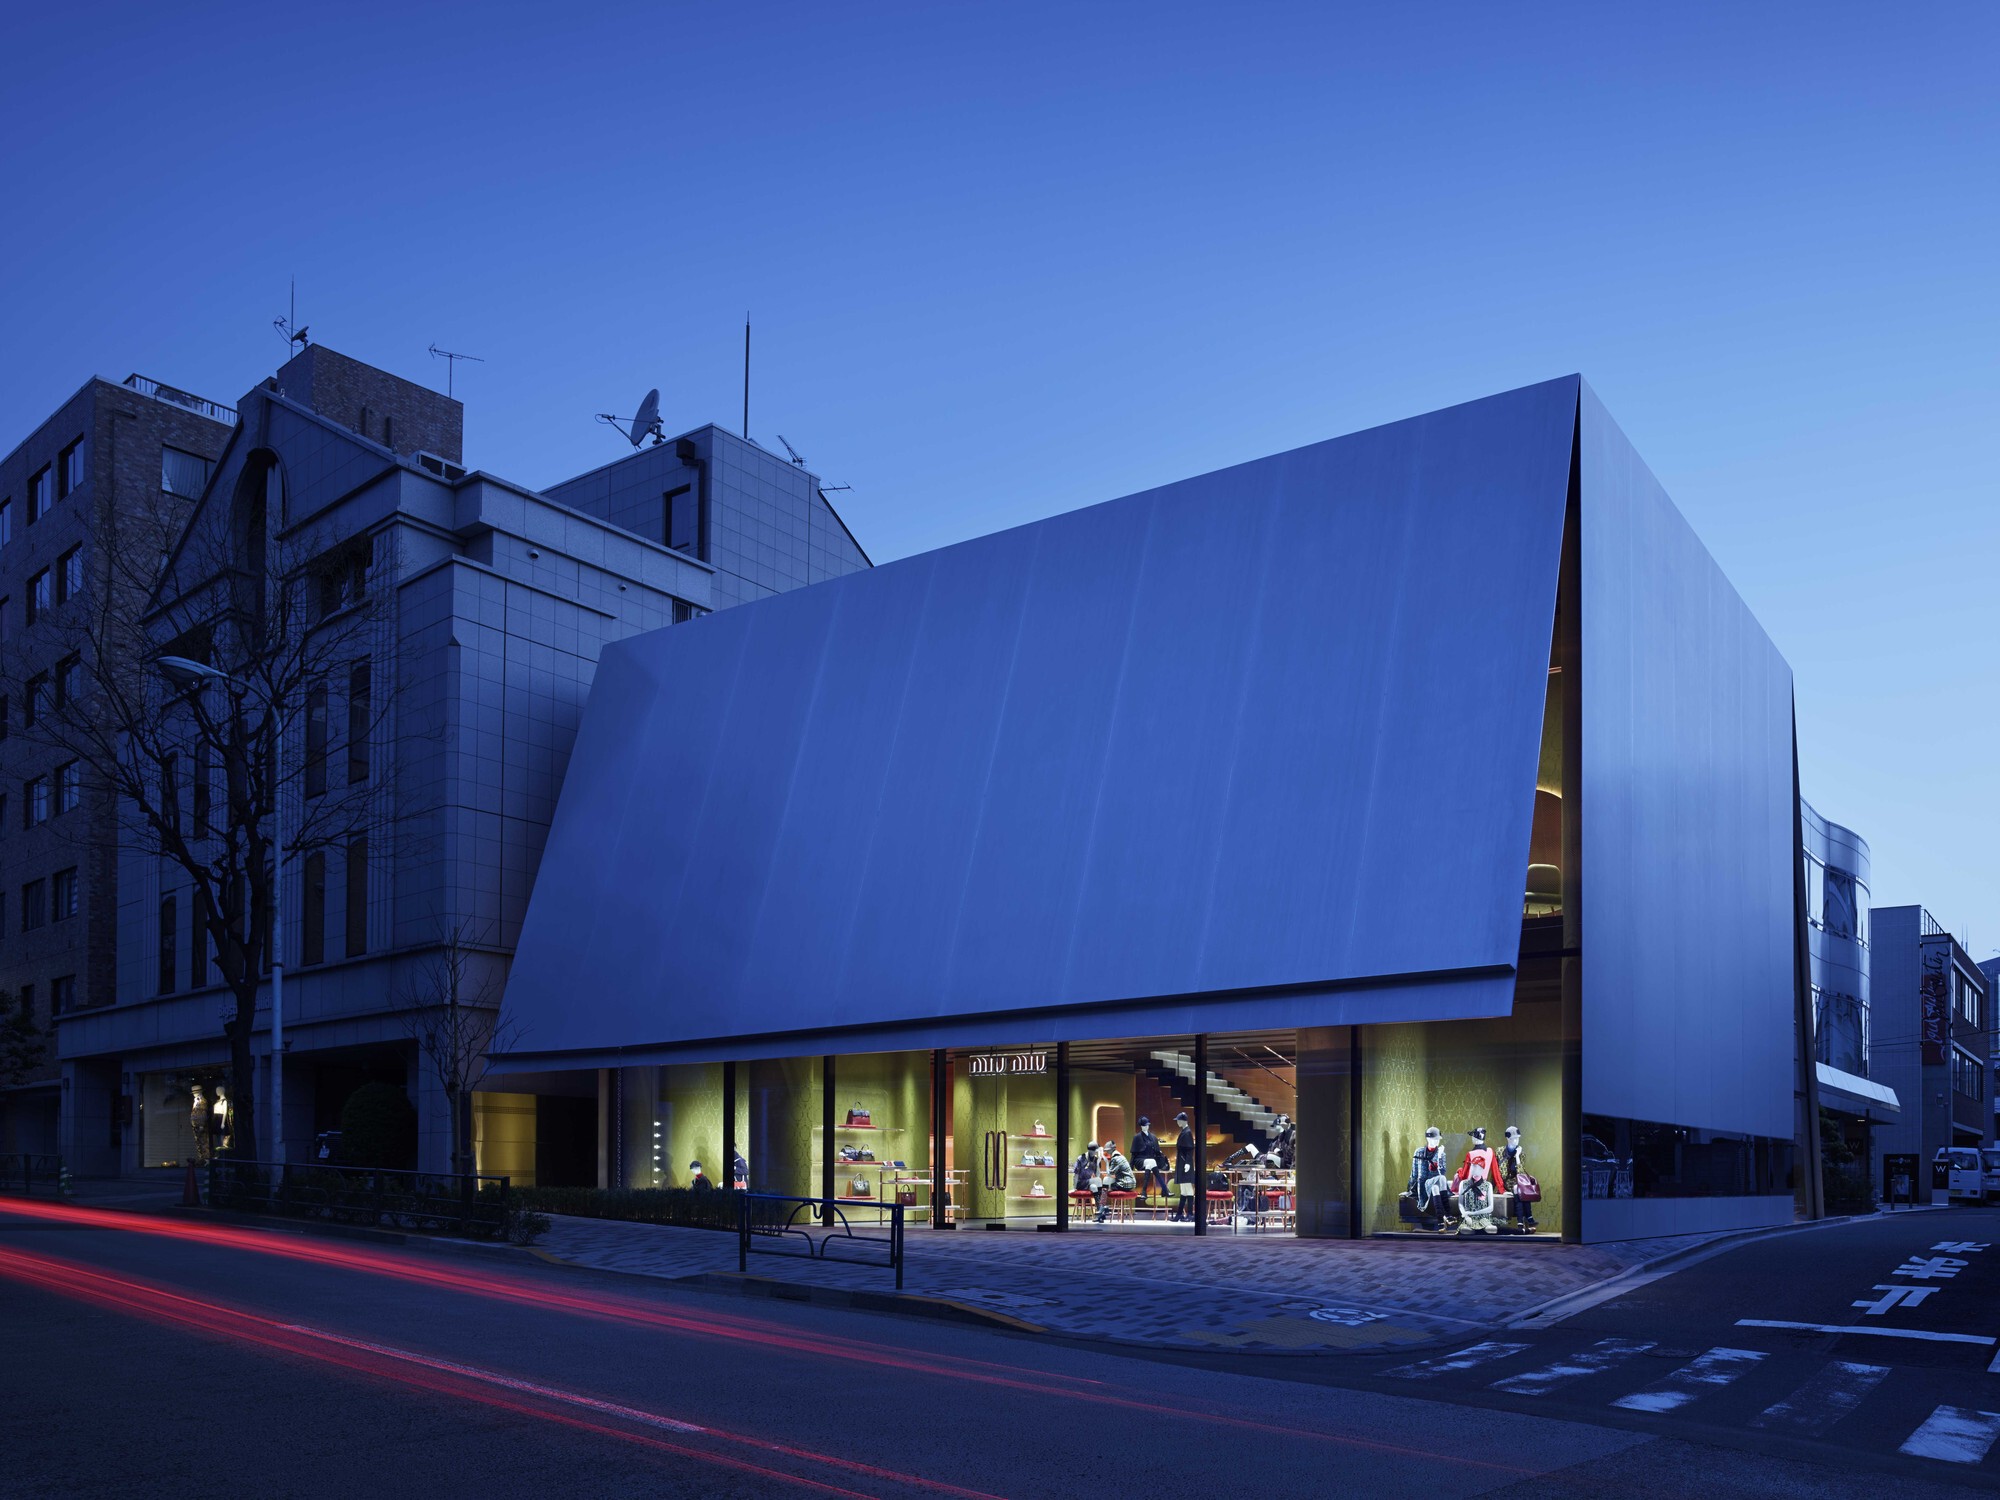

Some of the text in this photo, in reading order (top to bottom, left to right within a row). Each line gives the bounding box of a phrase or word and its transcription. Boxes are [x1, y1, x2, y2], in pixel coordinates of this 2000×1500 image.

[972, 1054, 1046, 1073] miu miu
[1935, 1165, 1947, 1173] W
